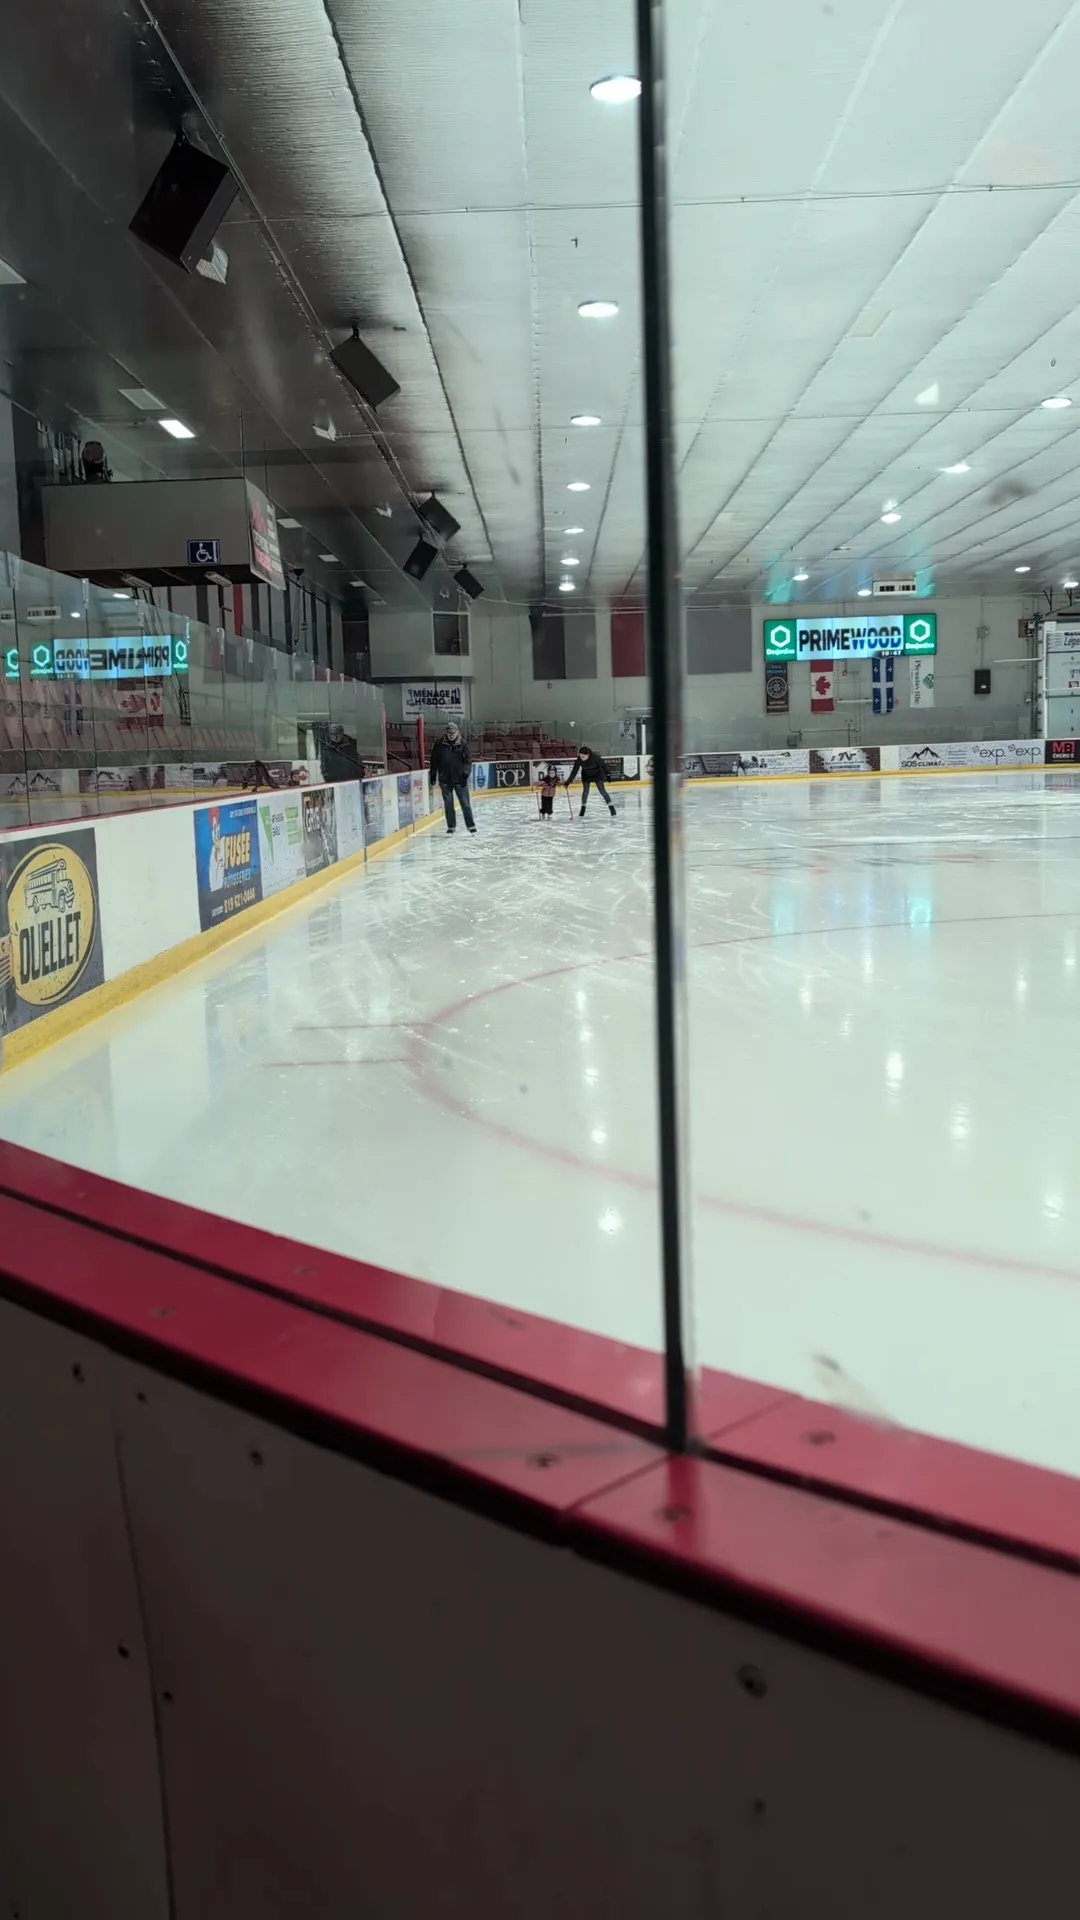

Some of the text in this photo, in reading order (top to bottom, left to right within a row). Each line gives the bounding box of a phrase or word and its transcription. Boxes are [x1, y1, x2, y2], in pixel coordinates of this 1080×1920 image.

[799, 626, 902, 652] PRIMEWOOD
[914, 659, 922, 704] Plessisville
[413, 688, 450, 698] MÉNAGE
[415, 697, 446, 705] HEBDO
[980, 746, 1006, 765] exp.
[1015, 744, 1043, 763] exp.
[1053, 741, 1075, 752] MB
[496, 769, 525, 787] POP
[224, 825, 251, 870] FUSÉE
[19, 911, 81, 985] OUELLET
